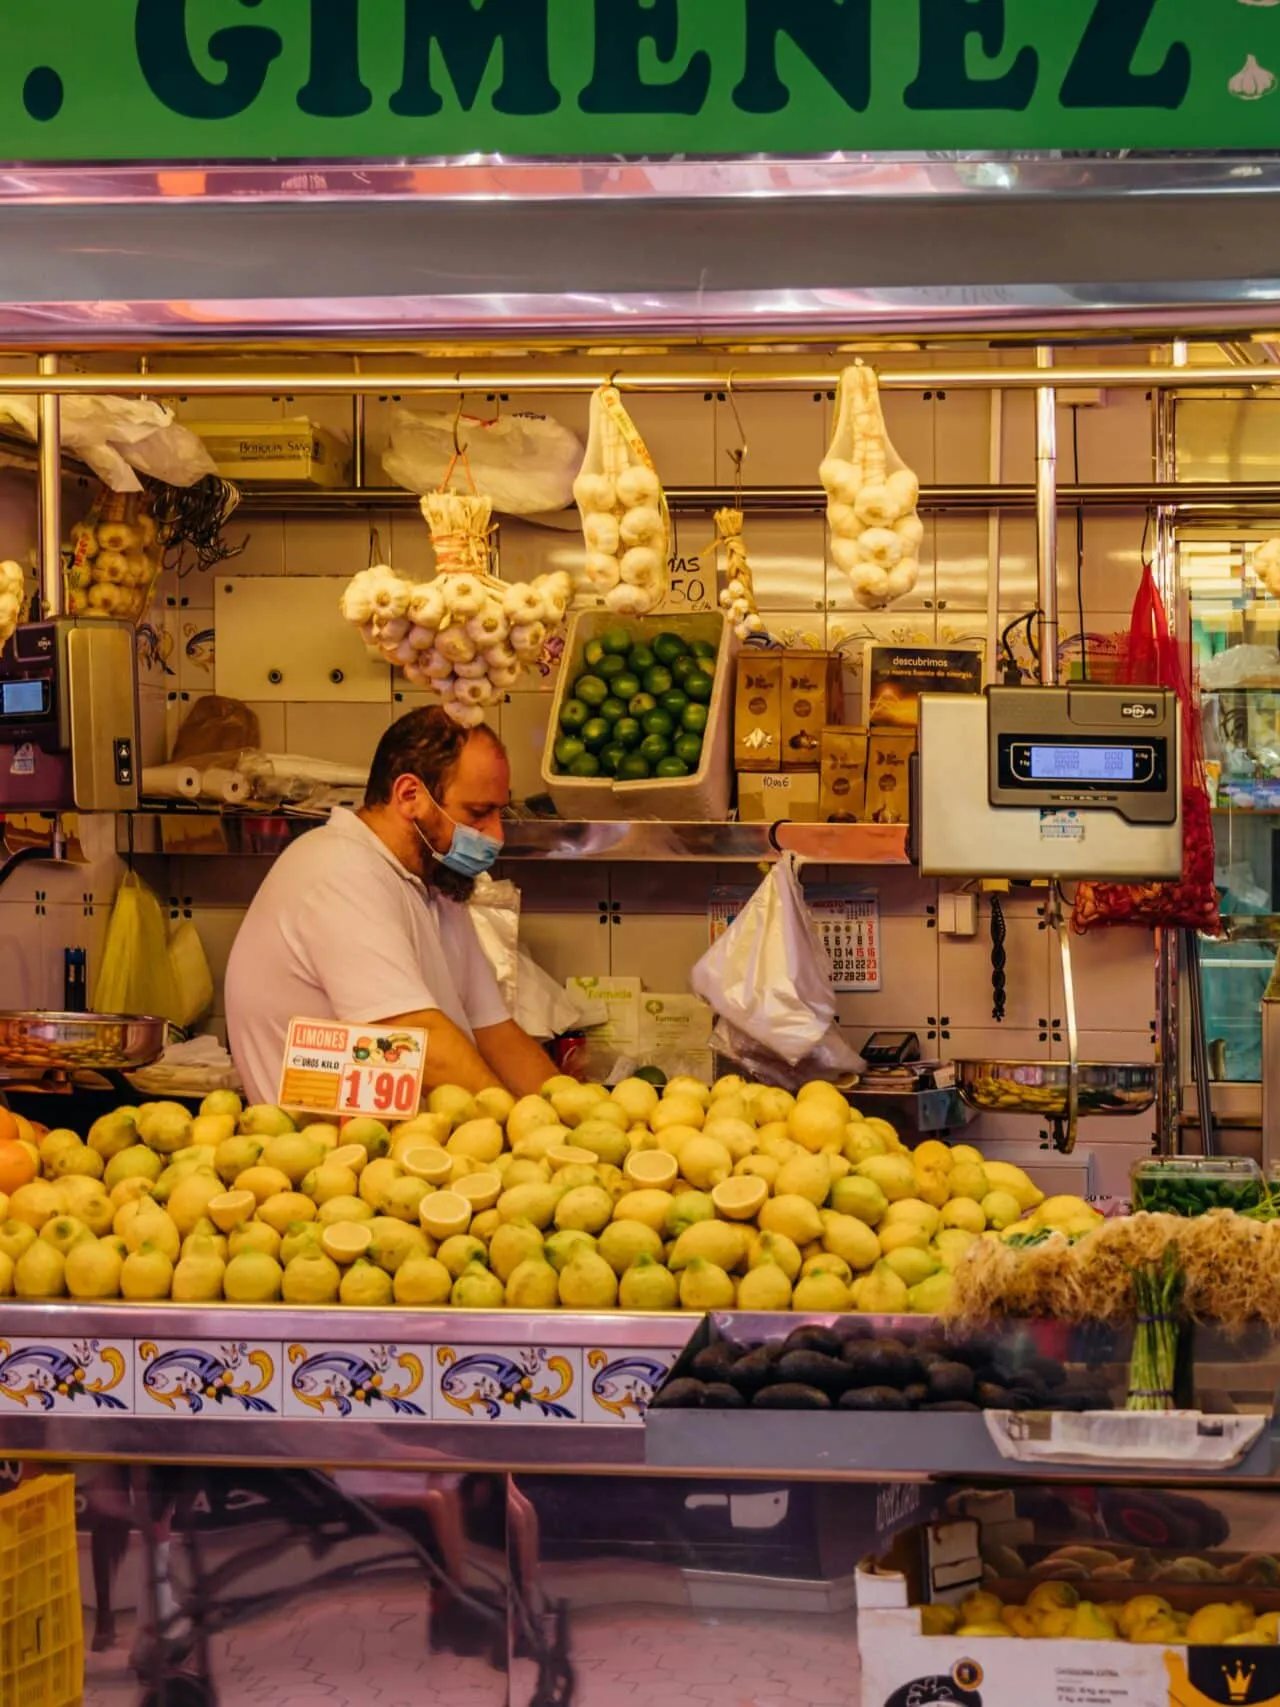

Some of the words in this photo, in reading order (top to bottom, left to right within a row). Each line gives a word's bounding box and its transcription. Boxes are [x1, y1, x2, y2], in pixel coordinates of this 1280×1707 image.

[892, 655, 948, 668] descubrimos
[1122, 704, 1155, 718] DINA
[823, 936, 830, 946] 5
[834, 936, 841, 946] 6
[846, 935, 852, 945] 7
[857, 935, 863, 946] 8
[833, 947, 842, 958] 13
[845, 947, 853, 958] 14
[856, 948, 865, 957] 15
[867, 947, 875, 957] 16
[833, 959, 844, 970] 20
[845, 959, 854, 970] 21
[855, 959, 866, 970] 22
[867, 959, 876, 970] 23
[833, 971, 843, 981] 27
[844, 971, 855, 981] 28
[855, 971, 866, 981] 29
[866, 971, 877, 981] 30
[295, 1026, 346, 1049] LIMONES
[321, 1059, 340, 1070] KILO
[344, 1069, 416, 1112] 1'90
